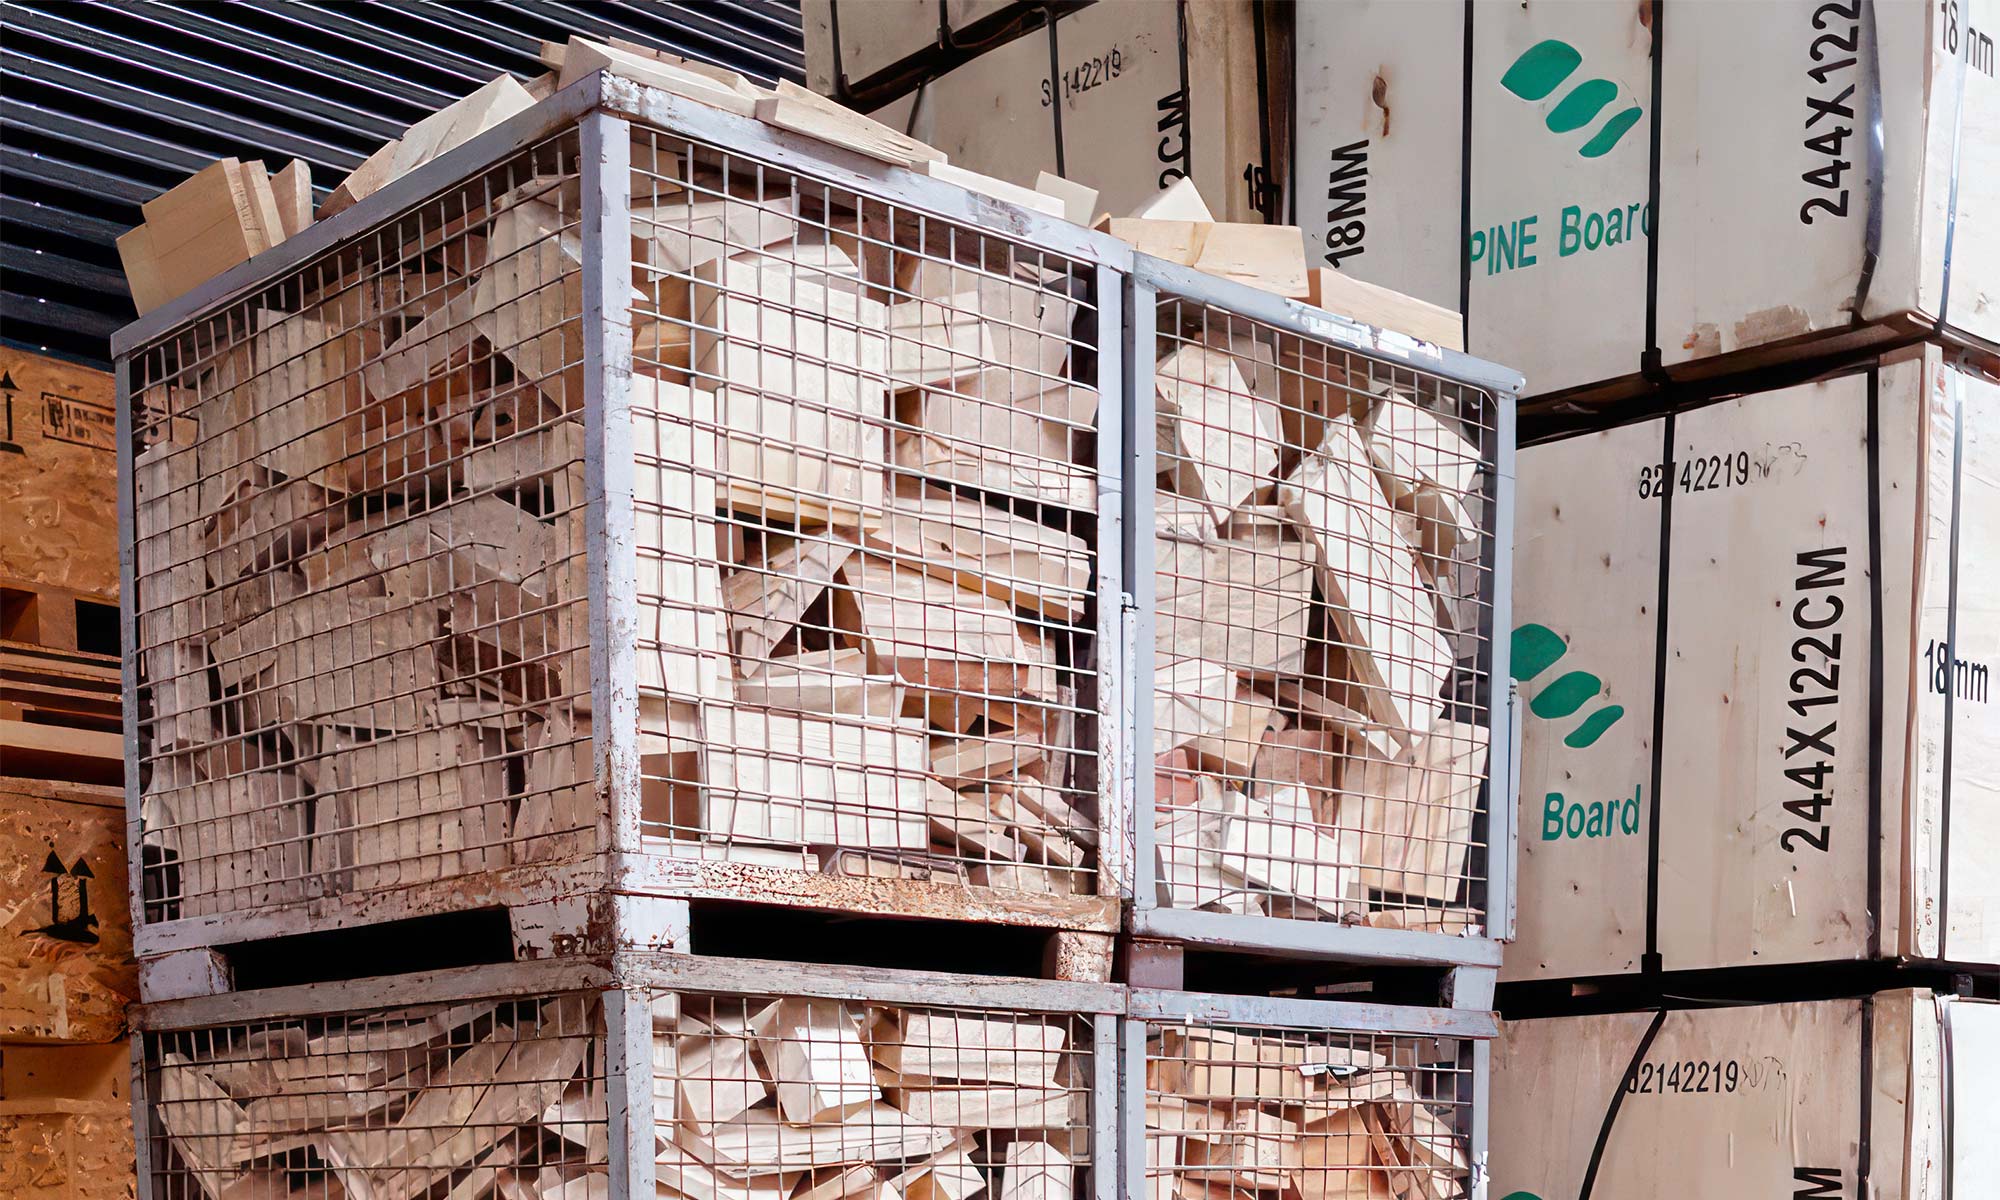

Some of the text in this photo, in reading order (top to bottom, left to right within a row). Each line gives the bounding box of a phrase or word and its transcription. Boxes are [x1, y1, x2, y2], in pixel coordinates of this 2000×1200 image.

[1324, 140, 1369, 268] 18MM
[1471, 215, 1538, 275] PINE
[1780, 547, 1847, 853] 244X122CM
[1542, 784, 1641, 840] Board
